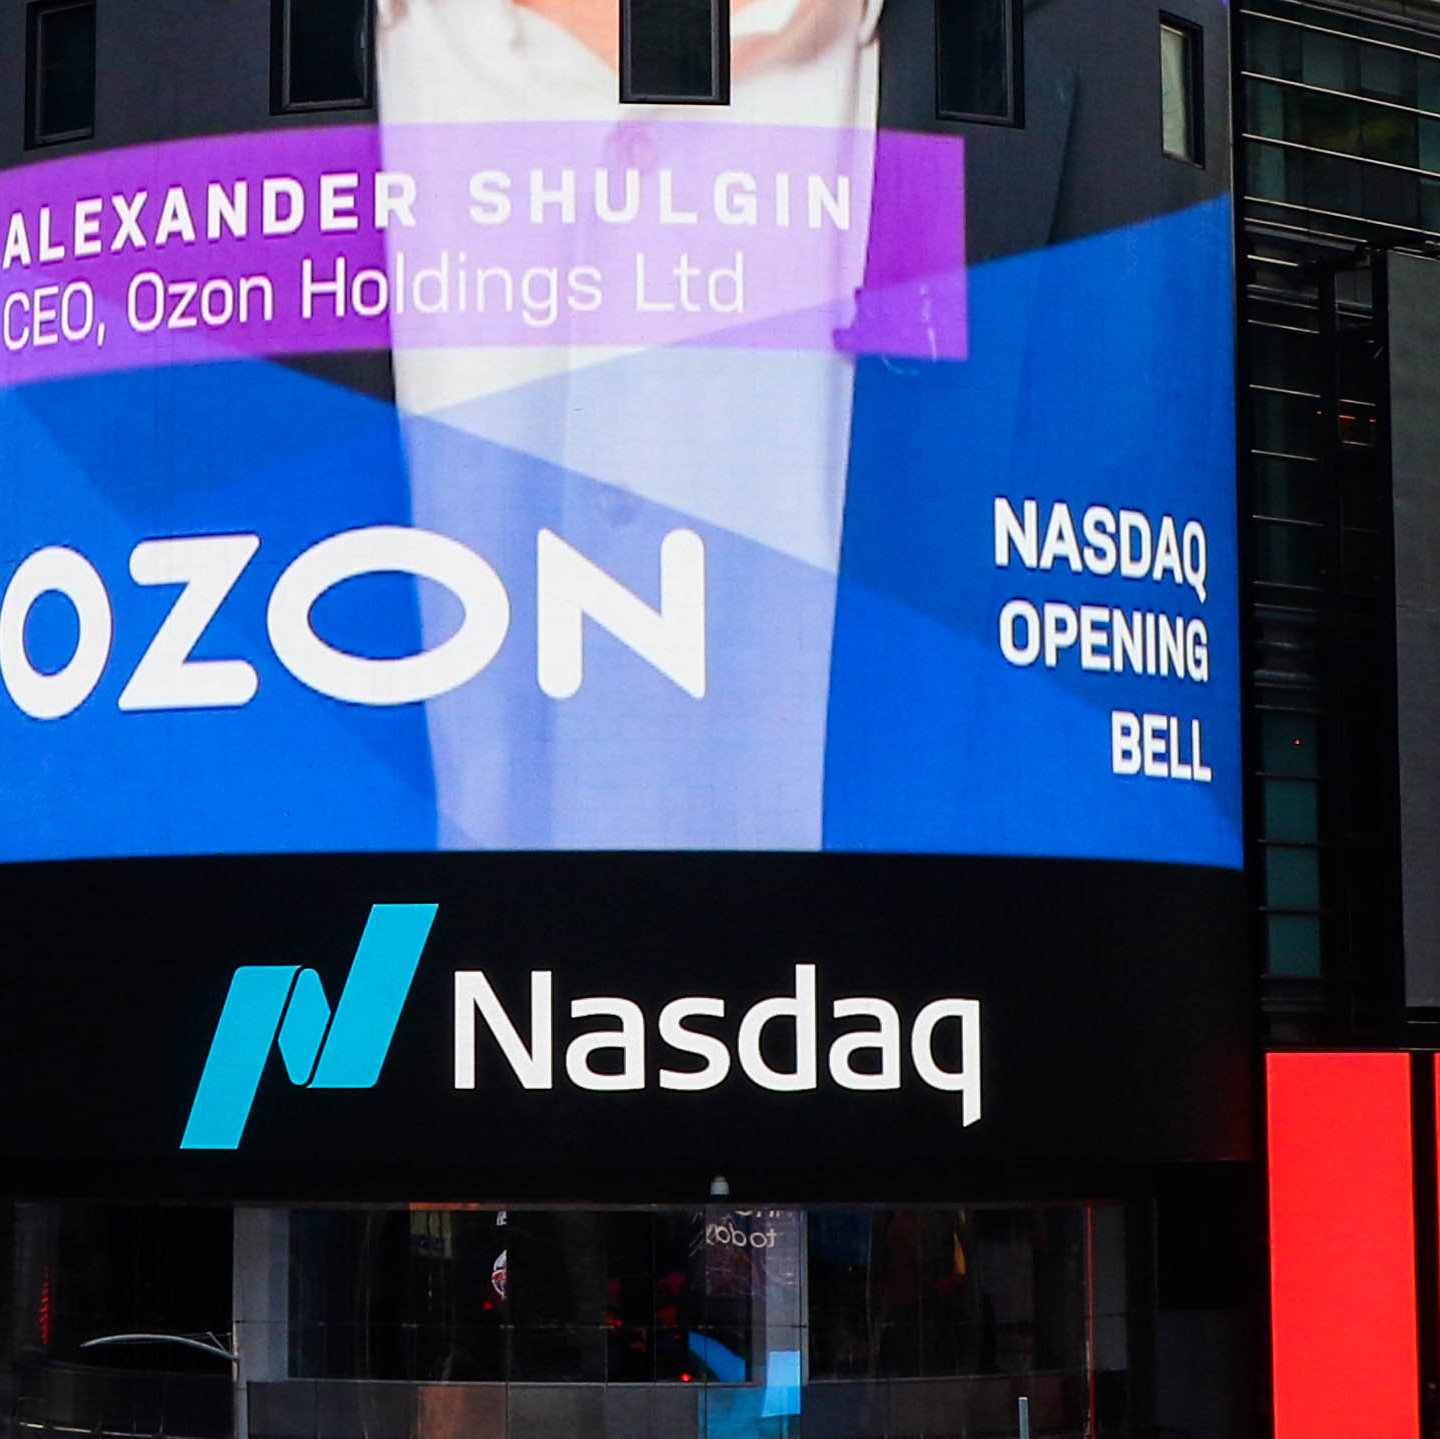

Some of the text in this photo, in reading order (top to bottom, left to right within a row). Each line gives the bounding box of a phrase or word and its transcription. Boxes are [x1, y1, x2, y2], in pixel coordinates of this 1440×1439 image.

[1, 168, 851, 270] ALEXANDER SHULGIN
[2, 250, 745, 351] CEO, Ozon Holdings Ltd
[994, 496, 1208, 605] NASDAQ
[998, 598, 1209, 683] OPENING
[1111, 709, 1213, 783] BELL
[454, 963, 982, 1128] Nasdaq
